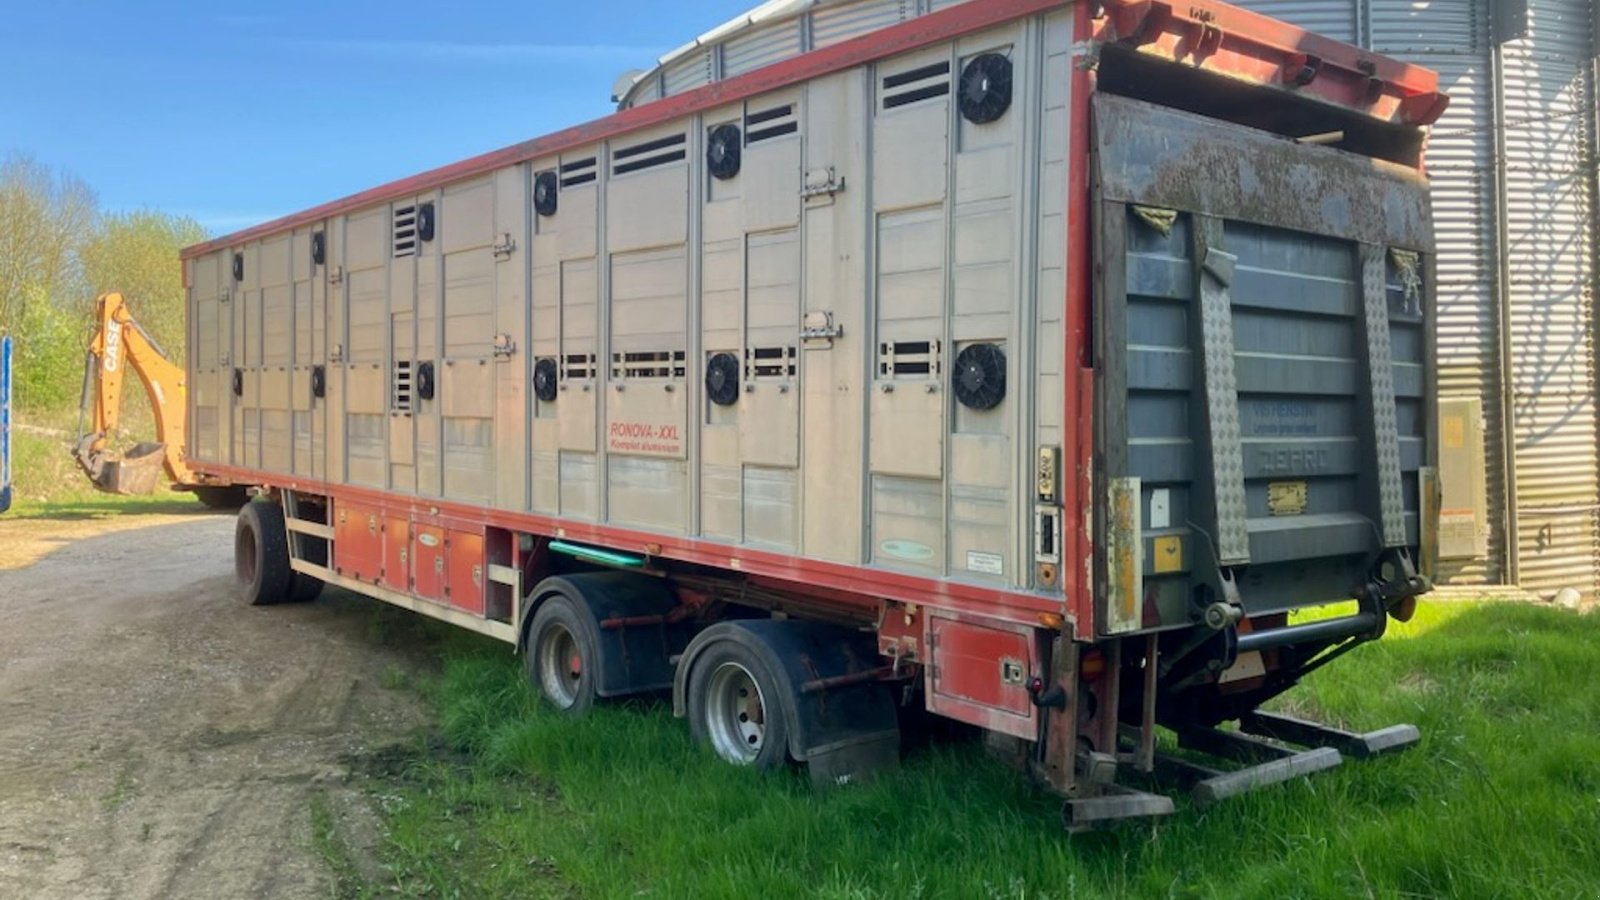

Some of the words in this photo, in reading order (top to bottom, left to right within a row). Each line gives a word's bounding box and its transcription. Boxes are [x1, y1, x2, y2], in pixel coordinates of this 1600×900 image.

[104, 319, 120, 372] CASE
[610, 422, 653, 438] RONOVA
[659, 424, 679, 440] XXL
